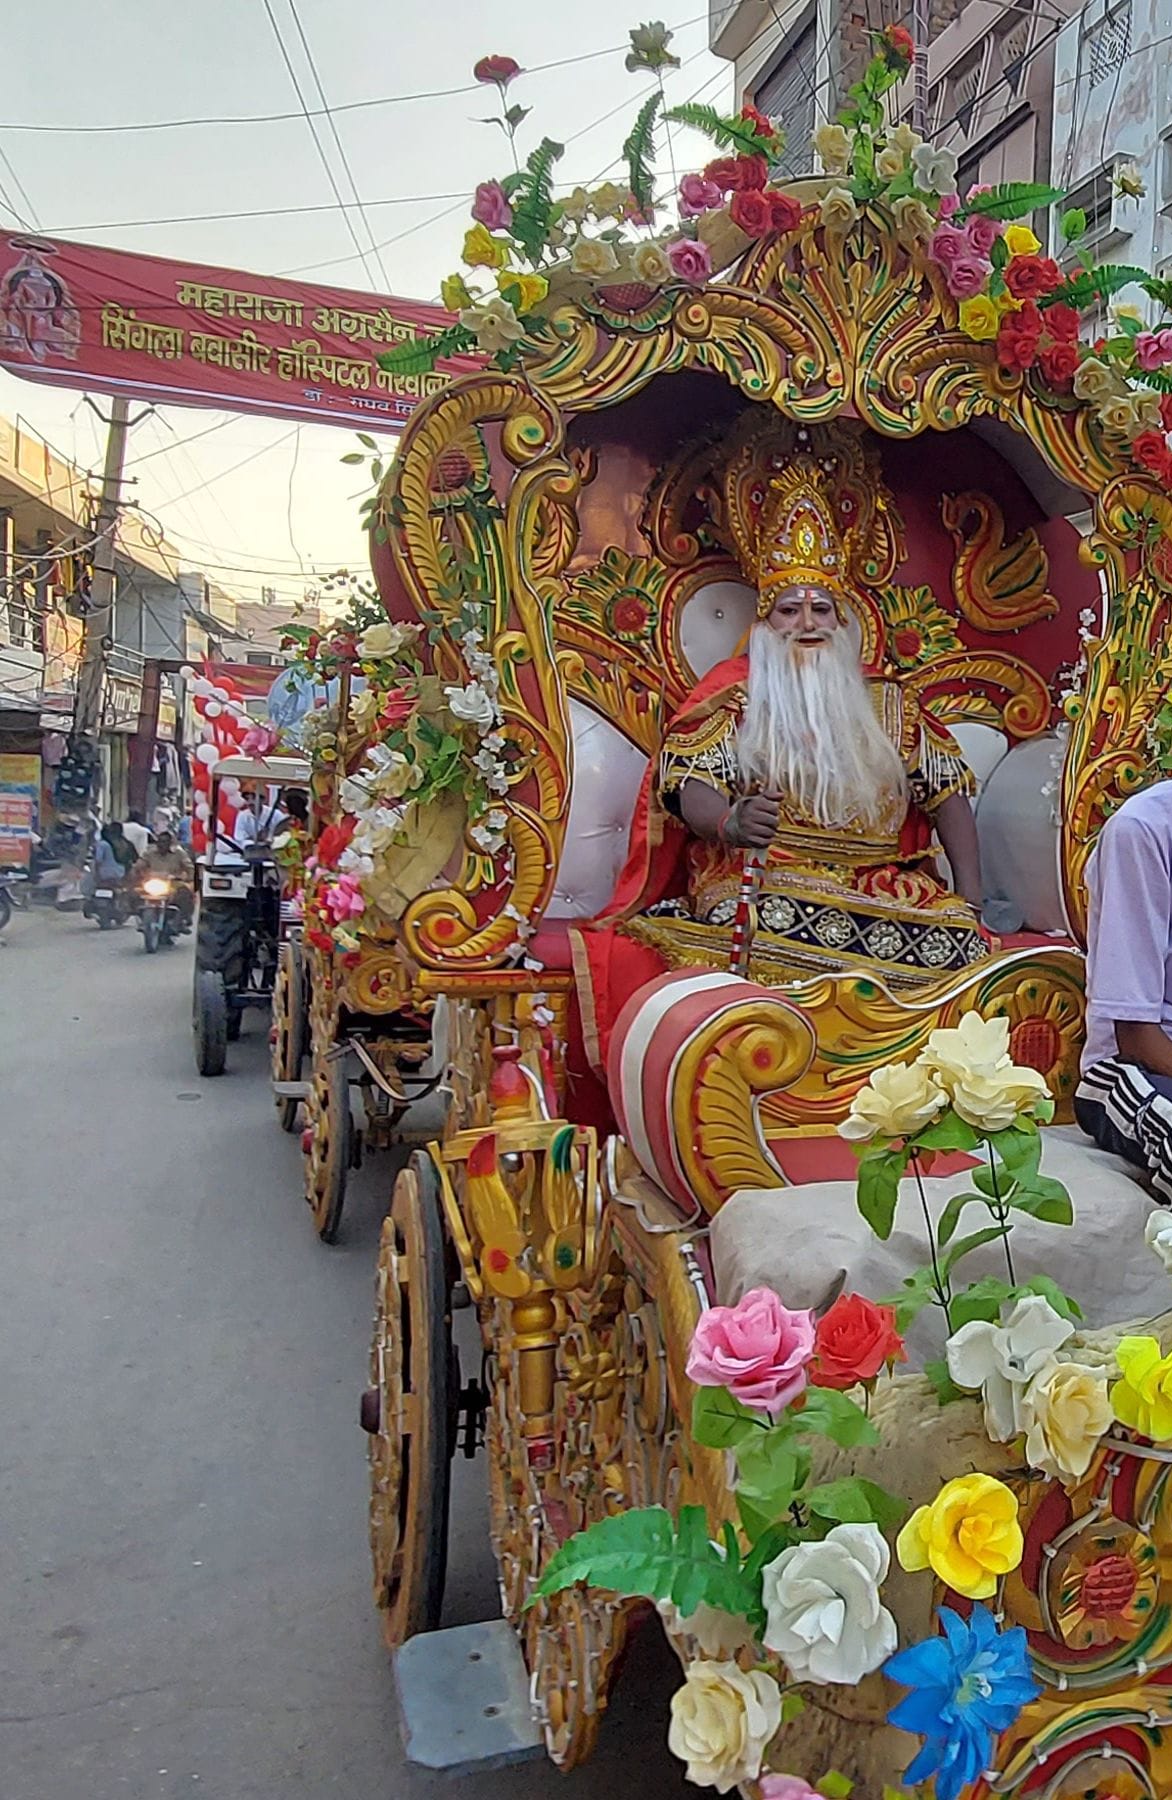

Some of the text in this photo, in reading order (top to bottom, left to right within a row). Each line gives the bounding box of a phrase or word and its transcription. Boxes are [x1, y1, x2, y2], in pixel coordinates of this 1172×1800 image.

[175, 280, 304, 327] महाराजा
[101, 301, 185, 360] सिंगला
[189, 328, 272, 374] बवासीर
